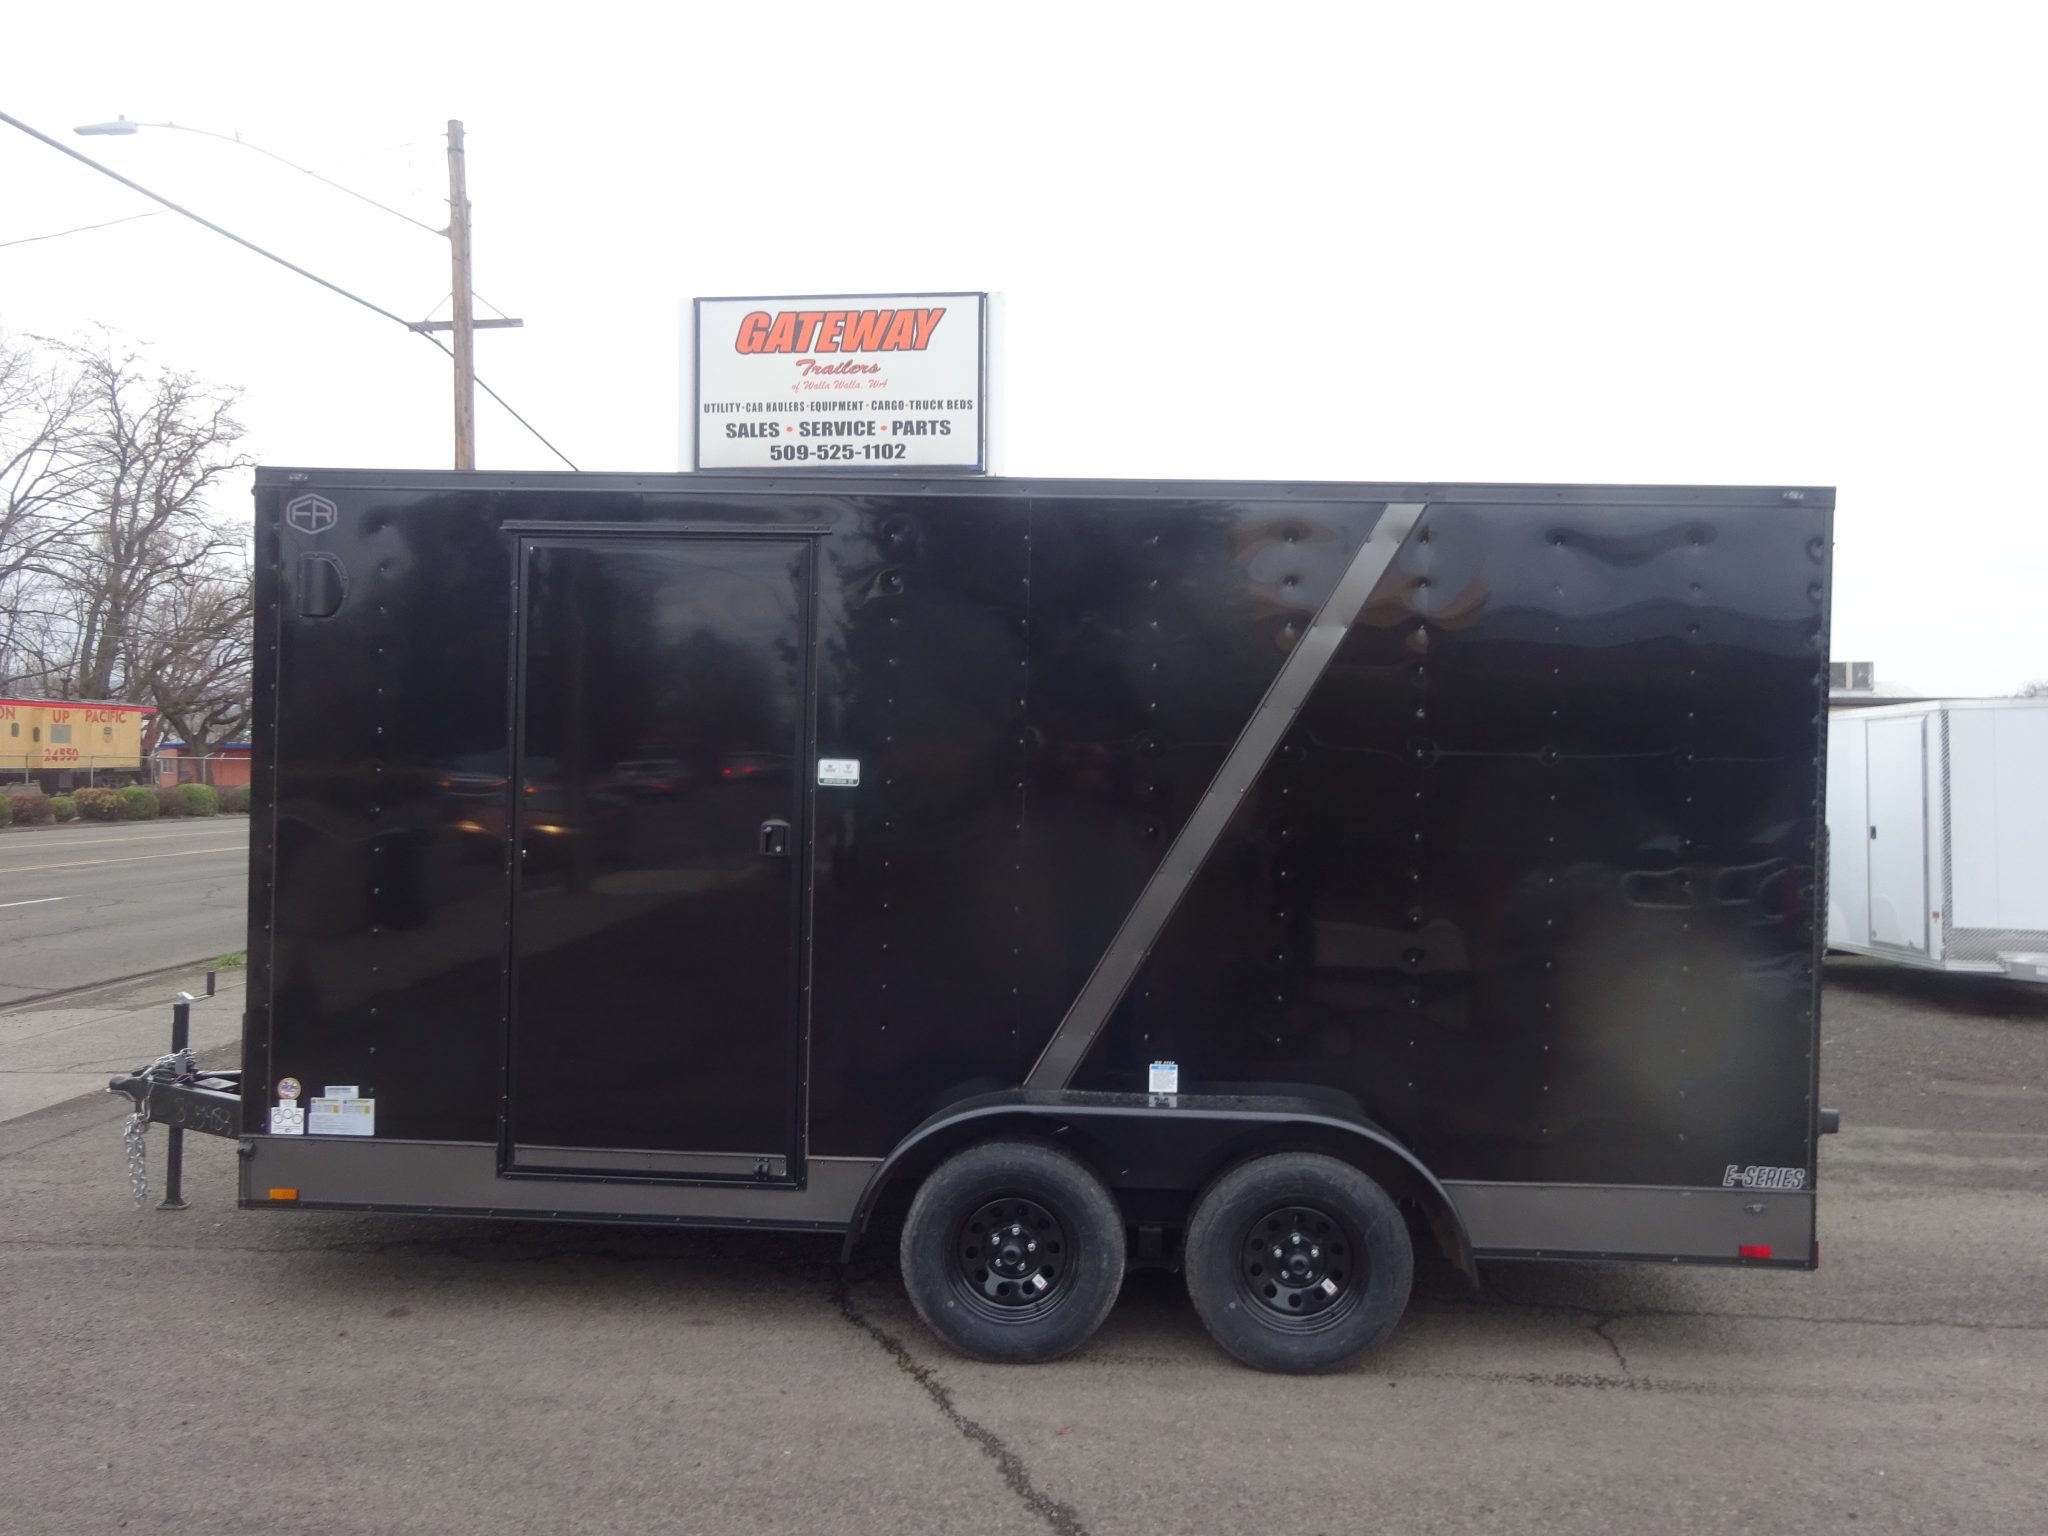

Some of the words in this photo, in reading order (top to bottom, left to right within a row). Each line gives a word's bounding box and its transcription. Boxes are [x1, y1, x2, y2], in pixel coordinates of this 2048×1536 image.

[735, 308, 947, 355] GATEWAY
[796, 359, 881, 377] Trailers
[803, 380, 830, 391] Walla
[704, 402, 741, 414] UTILITY
[746, 402, 764, 413] CAR
[766, 401, 805, 413] HAULERS
[810, 400, 864, 412] EQUIPMENT
[871, 400, 905, 411] CARGO
[909, 399, 944, 411] TRUCK
[947, 398, 974, 410] BEDS
[725, 421, 780, 439] SALES
[799, 420, 876, 437] SERVICE
[892, 419, 952, 436] PARTS
[770, 442, 906, 461] 509-525-1102
[52, 709, 71, 724] UP
[85, 709, 127, 724] PACIFIC
[1722, 1164, 1806, 1190] E-SERIES
